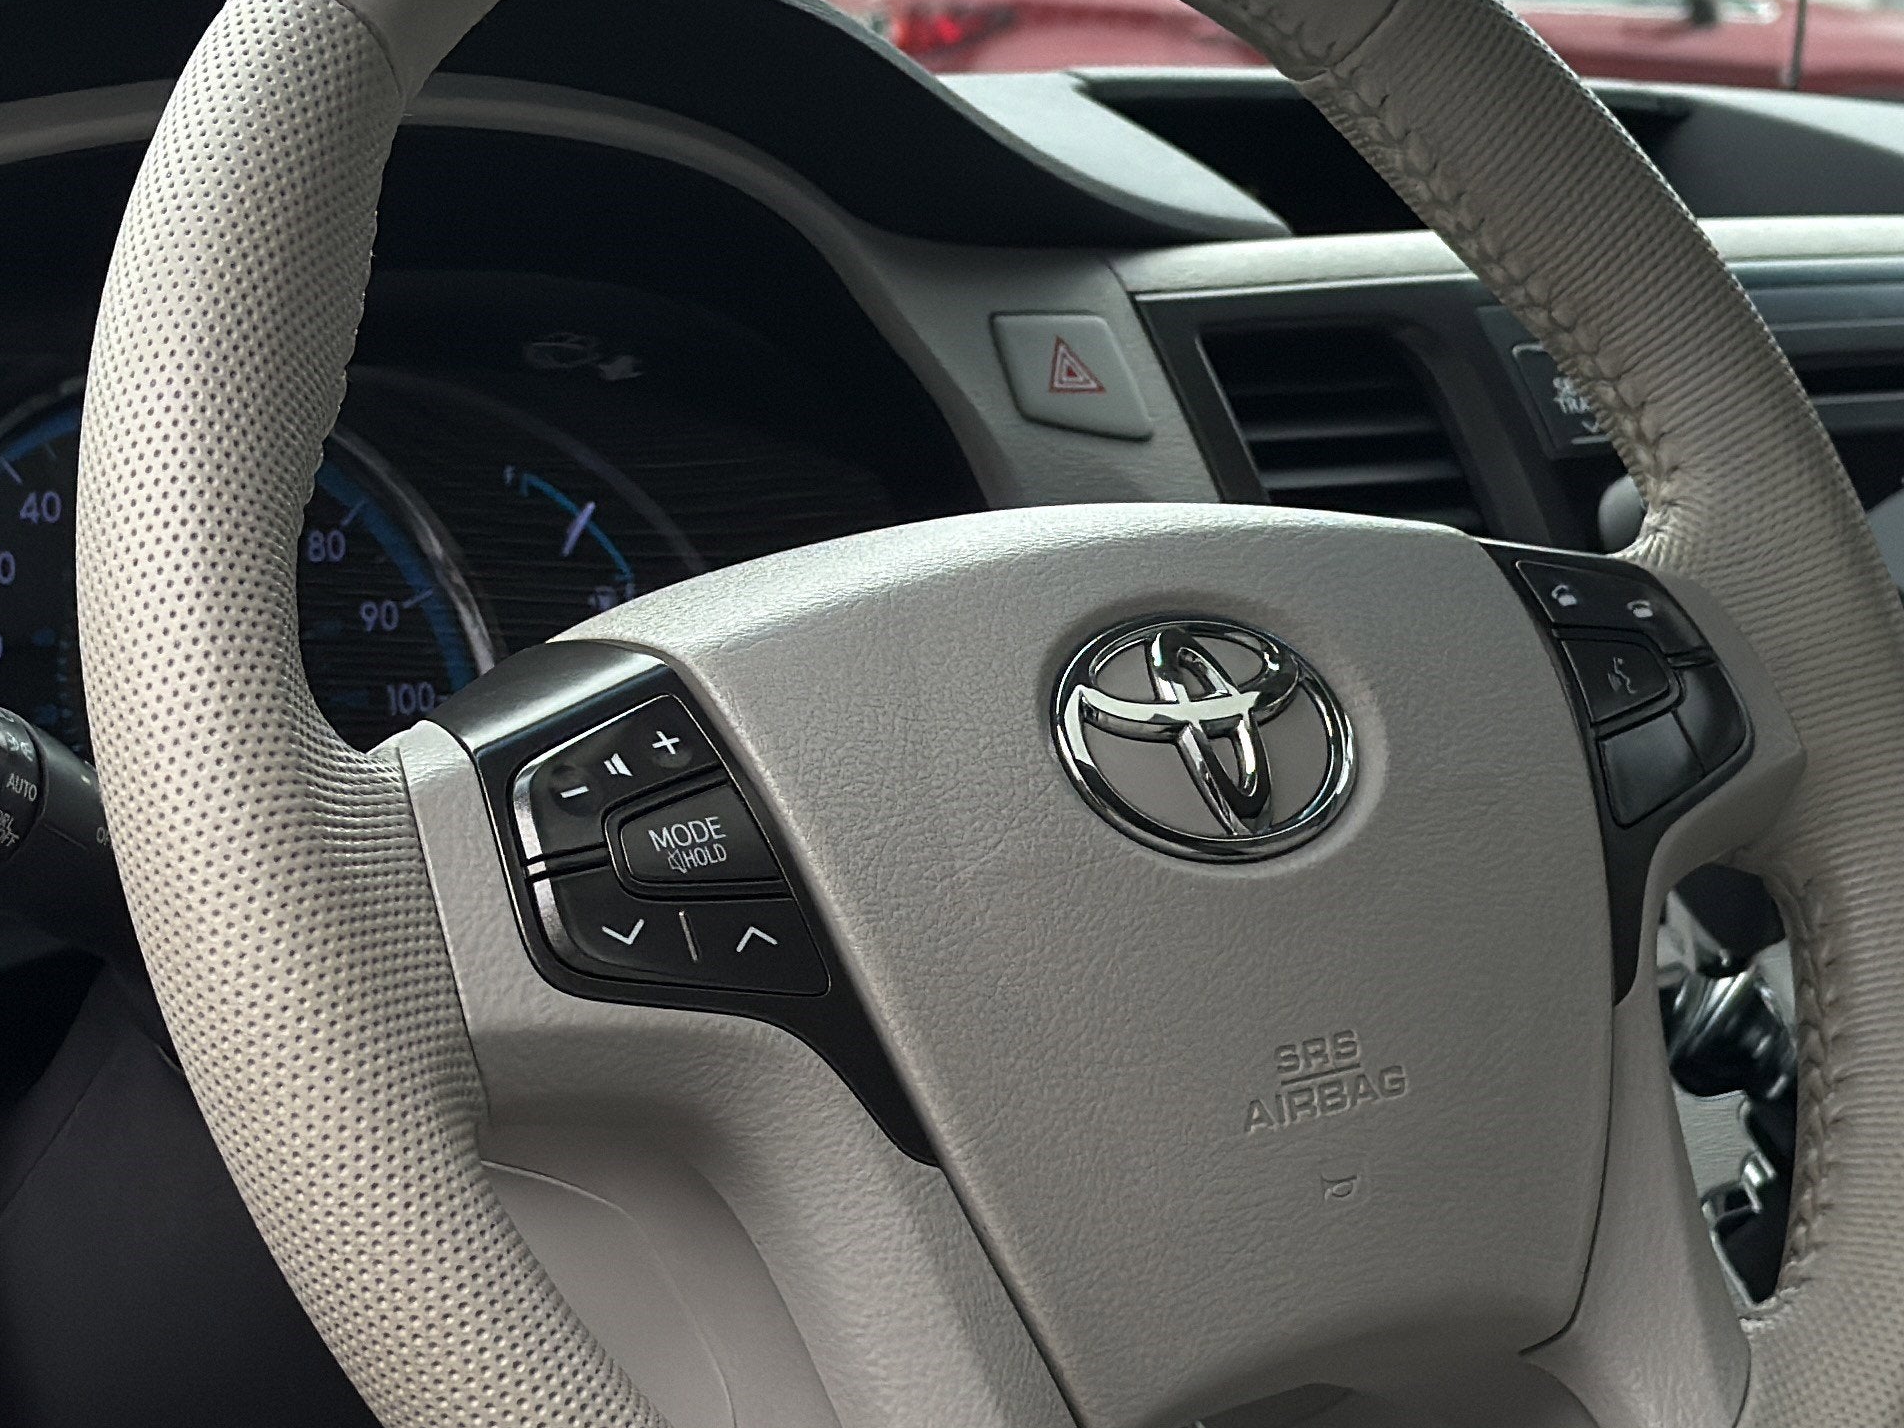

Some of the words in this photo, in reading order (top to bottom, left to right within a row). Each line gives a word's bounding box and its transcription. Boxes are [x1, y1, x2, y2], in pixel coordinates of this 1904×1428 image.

[19, 491, 61, 524] 40
[308, 527, 346, 563] 80
[359, 599, 398, 632] 90
[386, 682, 435, 715] 100
[6, 773, 37, 802] AUTO
[648, 816, 727, 852] MODE
[684, 845, 727, 873] HOLD
[1272, 1028, 1360, 1073] SRS
[1242, 1065, 1408, 1134] AIRBAG
